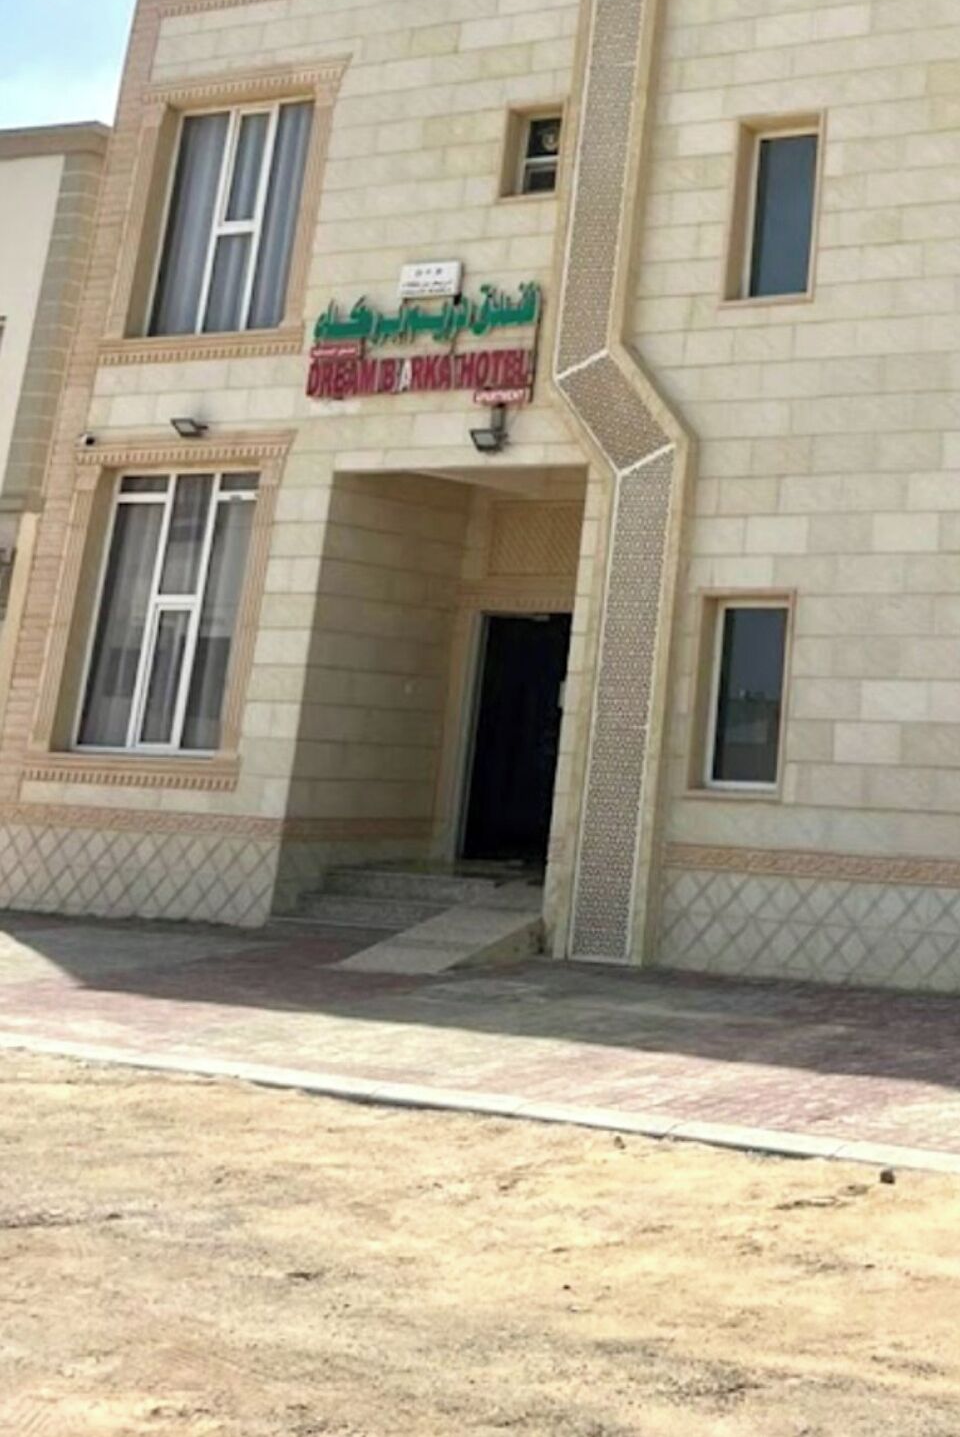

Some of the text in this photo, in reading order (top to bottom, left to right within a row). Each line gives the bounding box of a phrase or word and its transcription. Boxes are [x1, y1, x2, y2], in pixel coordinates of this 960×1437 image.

[306, 349, 531, 400] DREAM BARKA HOTEL
